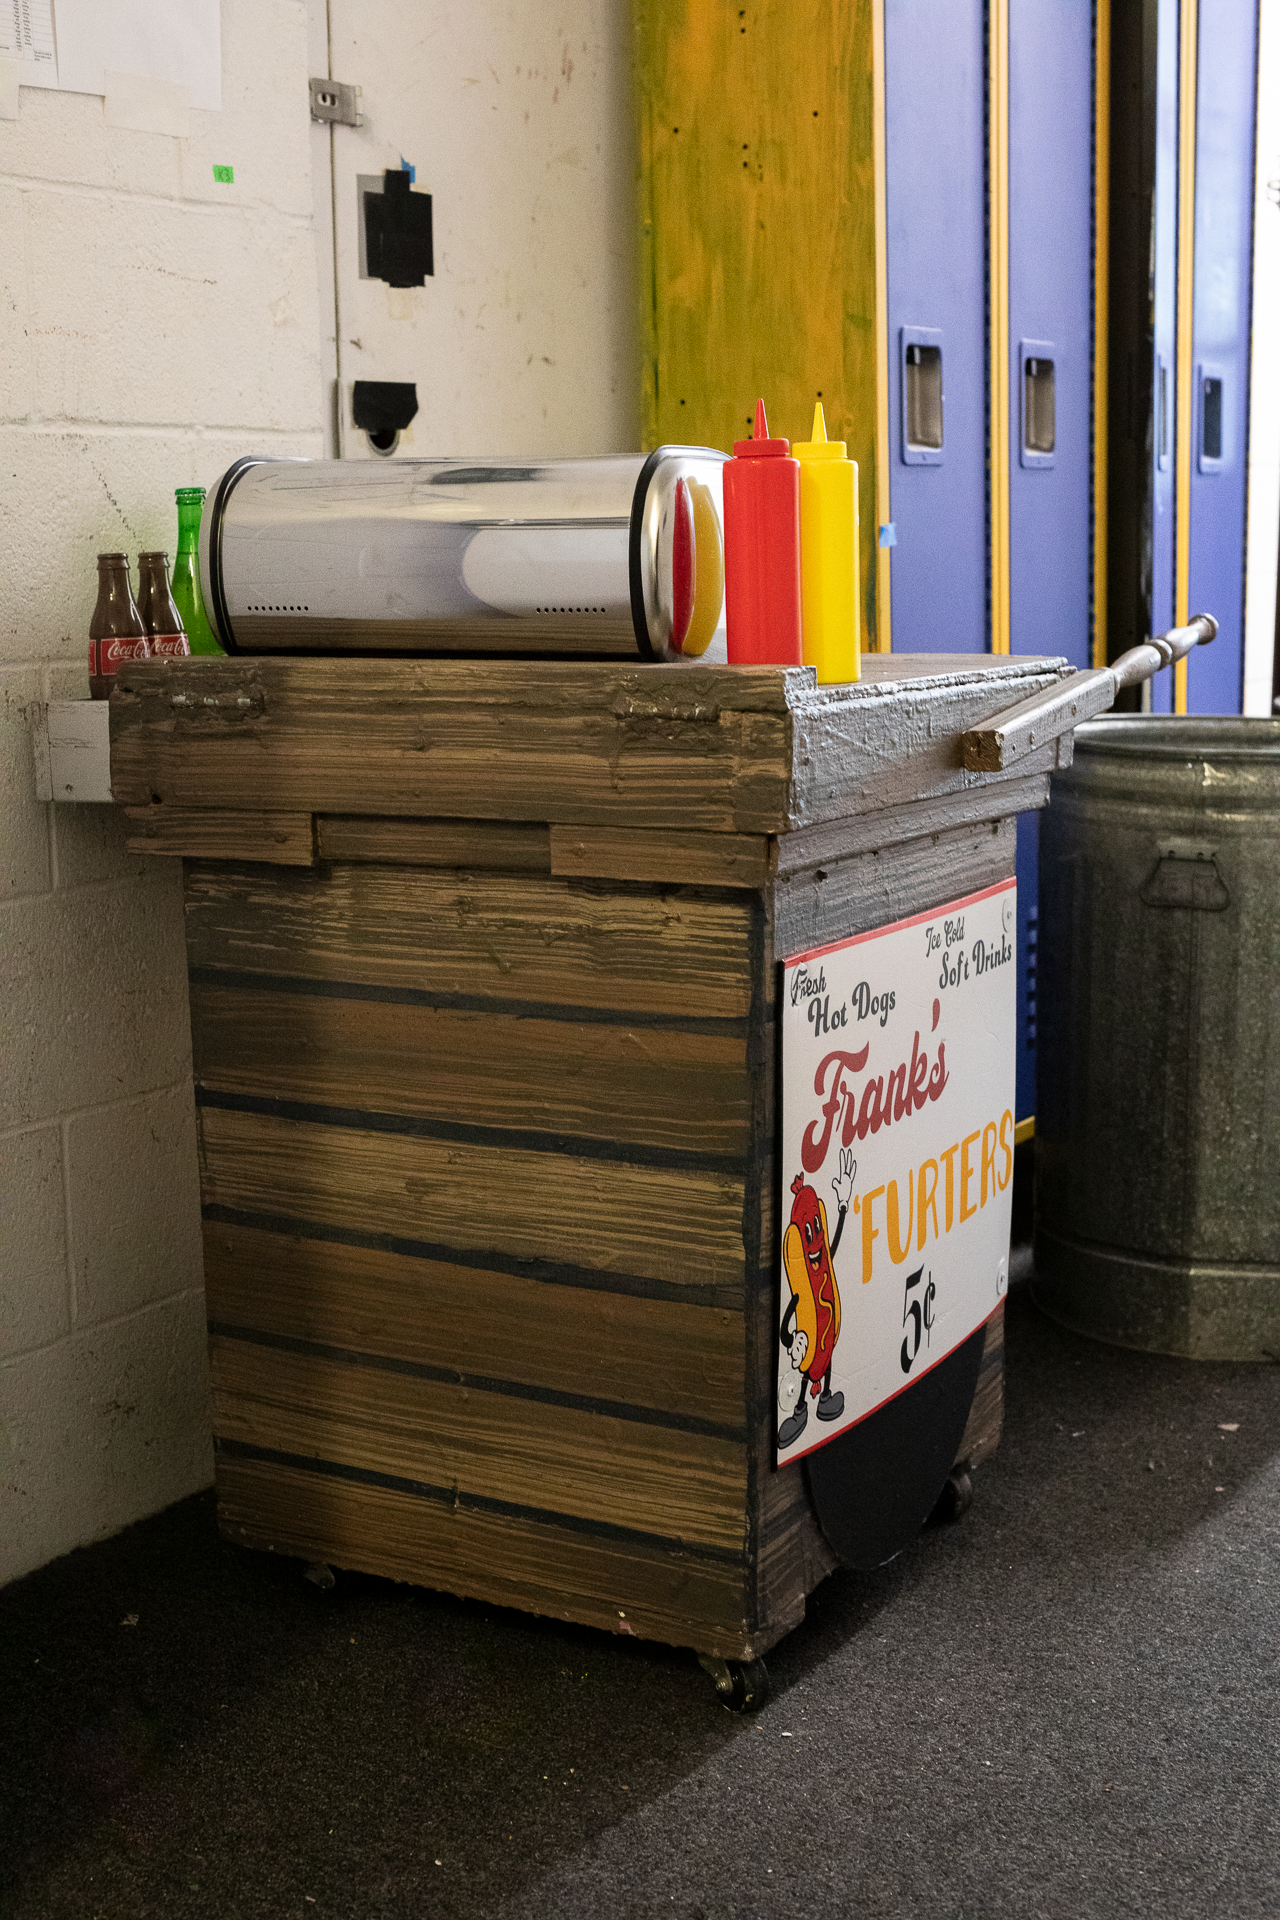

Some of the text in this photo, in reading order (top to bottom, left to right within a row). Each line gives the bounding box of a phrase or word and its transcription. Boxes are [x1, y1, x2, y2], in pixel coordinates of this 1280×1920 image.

[926, 916, 965, 958] Ice Cold
[939, 933, 1012, 989] Soft Drinks
[791, 965, 827, 1007] Fresh
[807, 981, 896, 1037] Hot Dogs
[801, 998, 949, 1174] Frank's
[900, 1263, 936, 1374] 5¢
